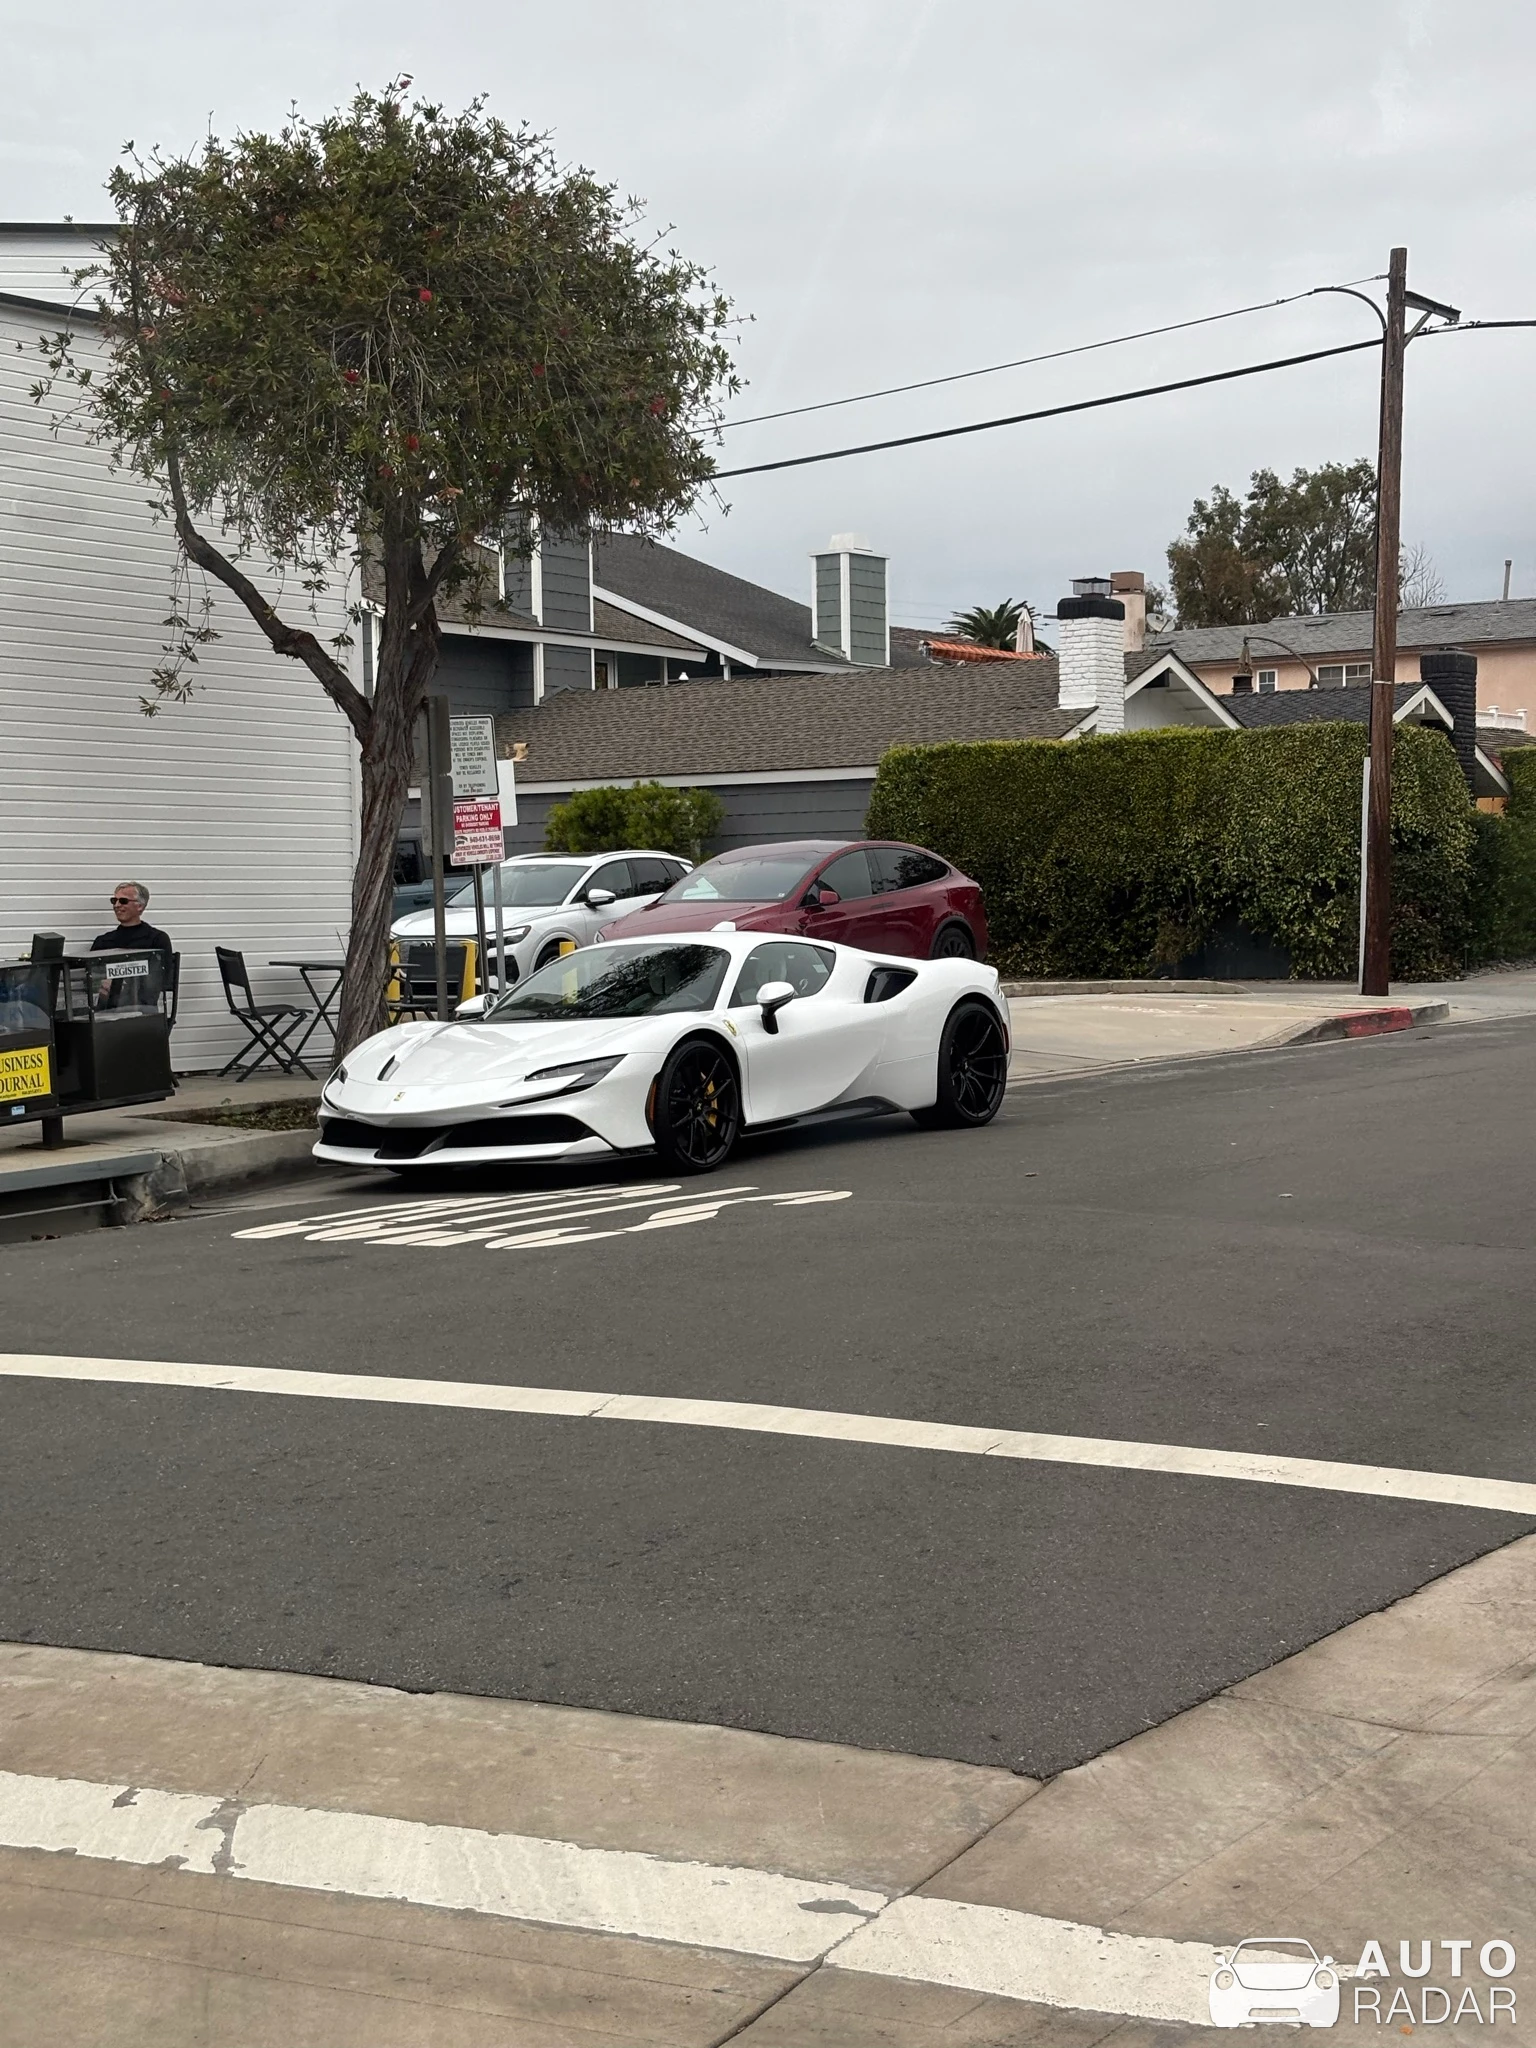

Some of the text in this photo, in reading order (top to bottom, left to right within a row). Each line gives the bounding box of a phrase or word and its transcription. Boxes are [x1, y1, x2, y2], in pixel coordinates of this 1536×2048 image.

[454, 804, 499, 813] USTOMER/TENANT
[456, 813, 493, 823] PARKING ONLY
[108, 965, 147, 977] REGISTER
[0, 1053, 43, 1073] USINESS
[0, 1073, 44, 1094] OURNAL
[231, 1184, 853, 1250] STOP
